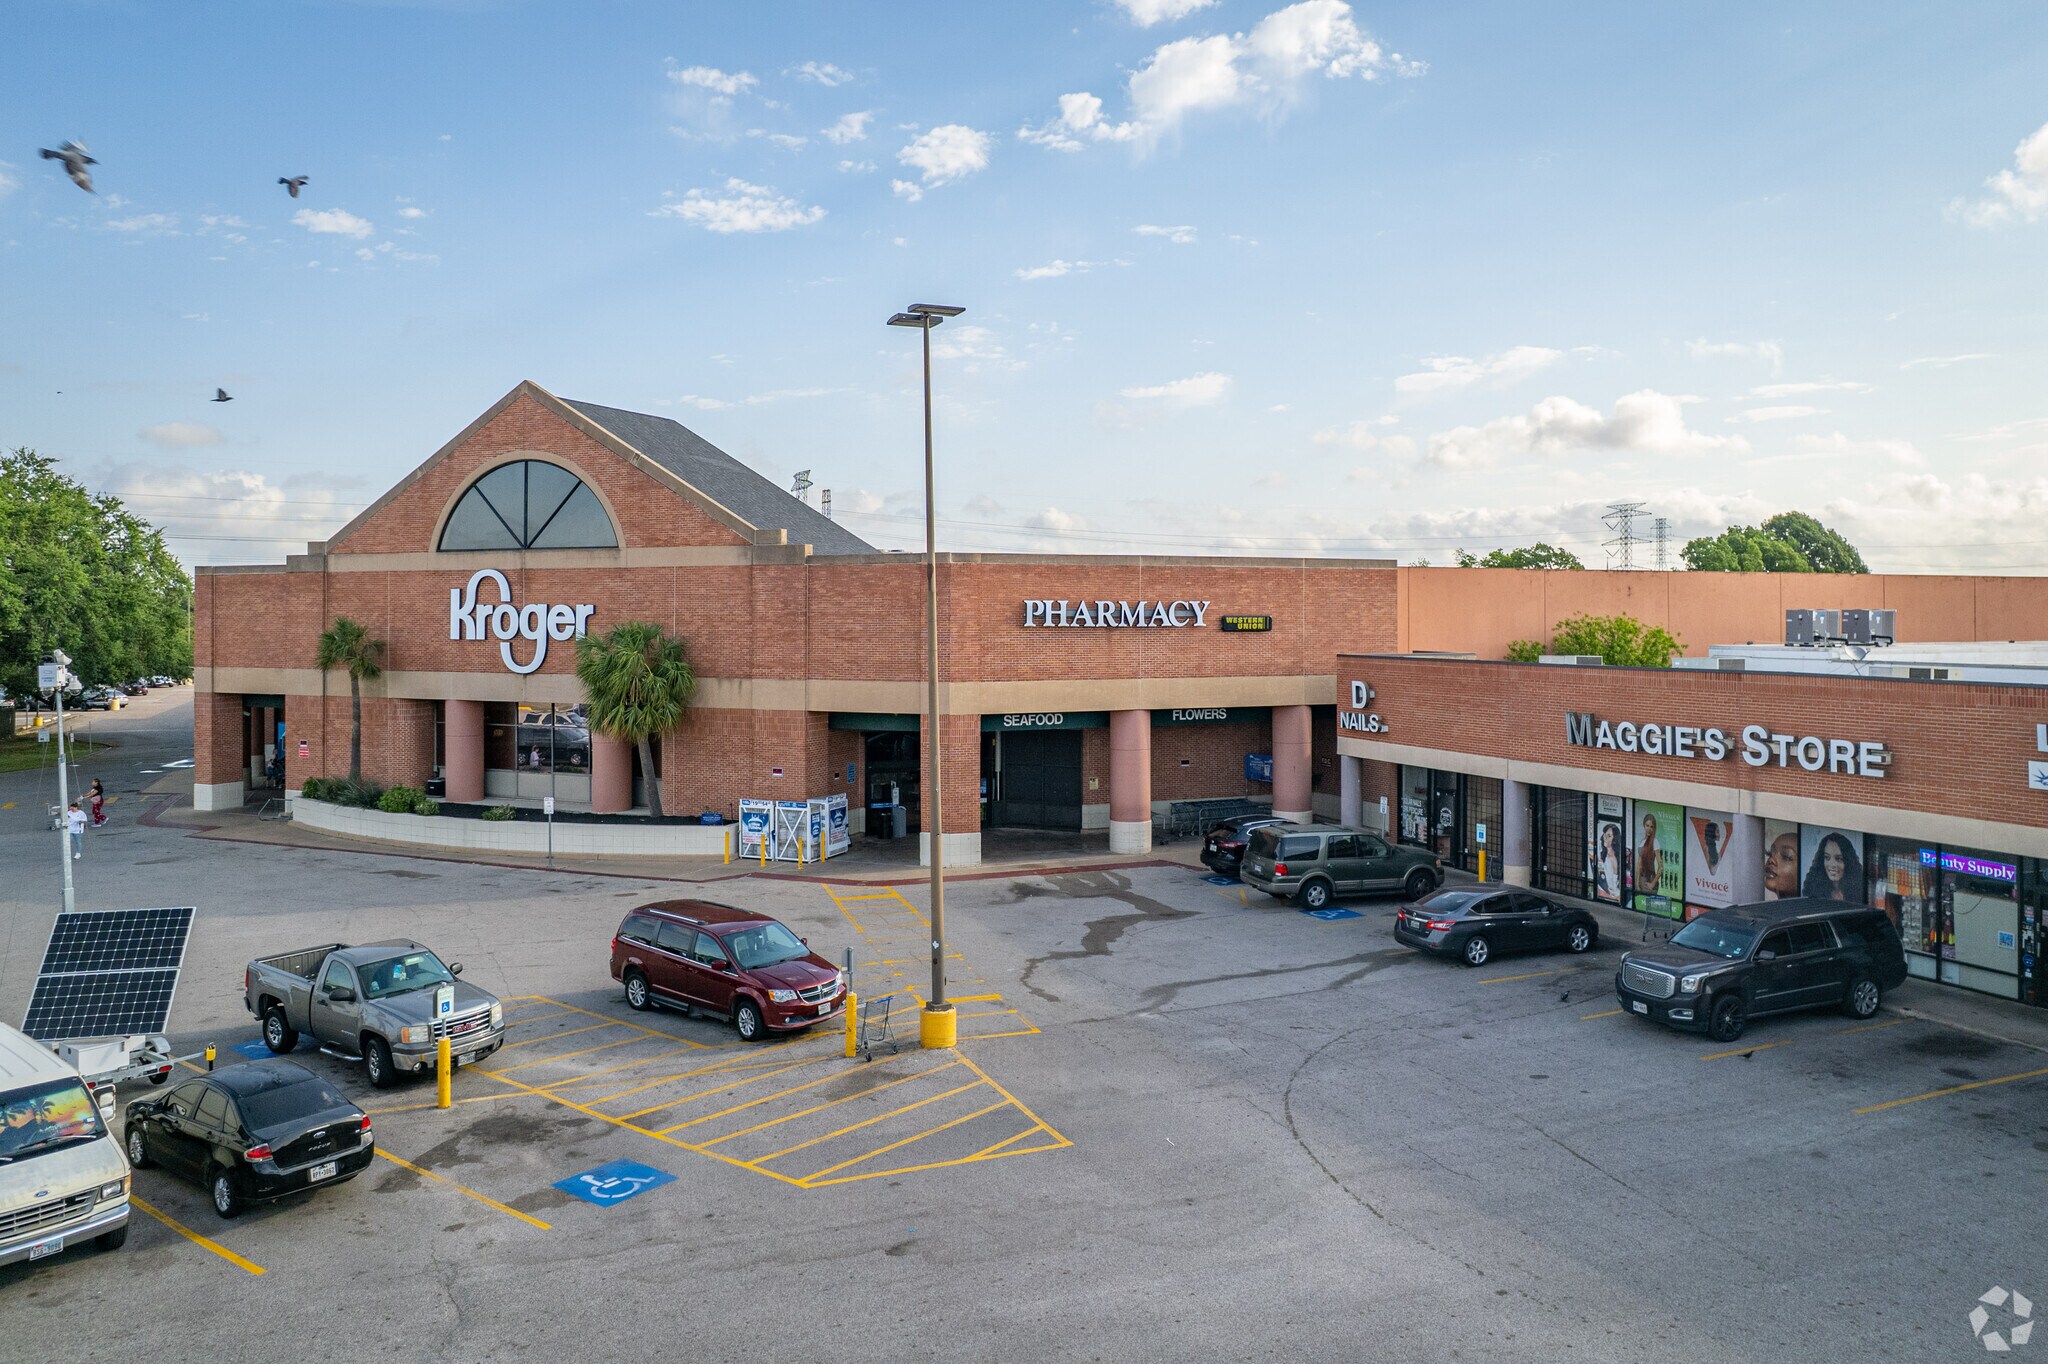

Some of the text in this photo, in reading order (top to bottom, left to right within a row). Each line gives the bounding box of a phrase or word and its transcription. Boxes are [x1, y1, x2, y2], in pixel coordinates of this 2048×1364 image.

[450, 568, 595, 674] Kroger
[1023, 600, 1211, 628] PHARMACY
[1352, 681, 1367, 708] D
[1003, 713, 1064, 727] SEAFOOD
[1172, 708, 1227, 721] FLOWERS
[1340, 712, 1379, 733] NAILS
[1565, 711, 1885, 778] MAGGIE'S STORE
[1968, 861, 2015, 880] Supply
[1695, 877, 1729, 893] Vivacé
